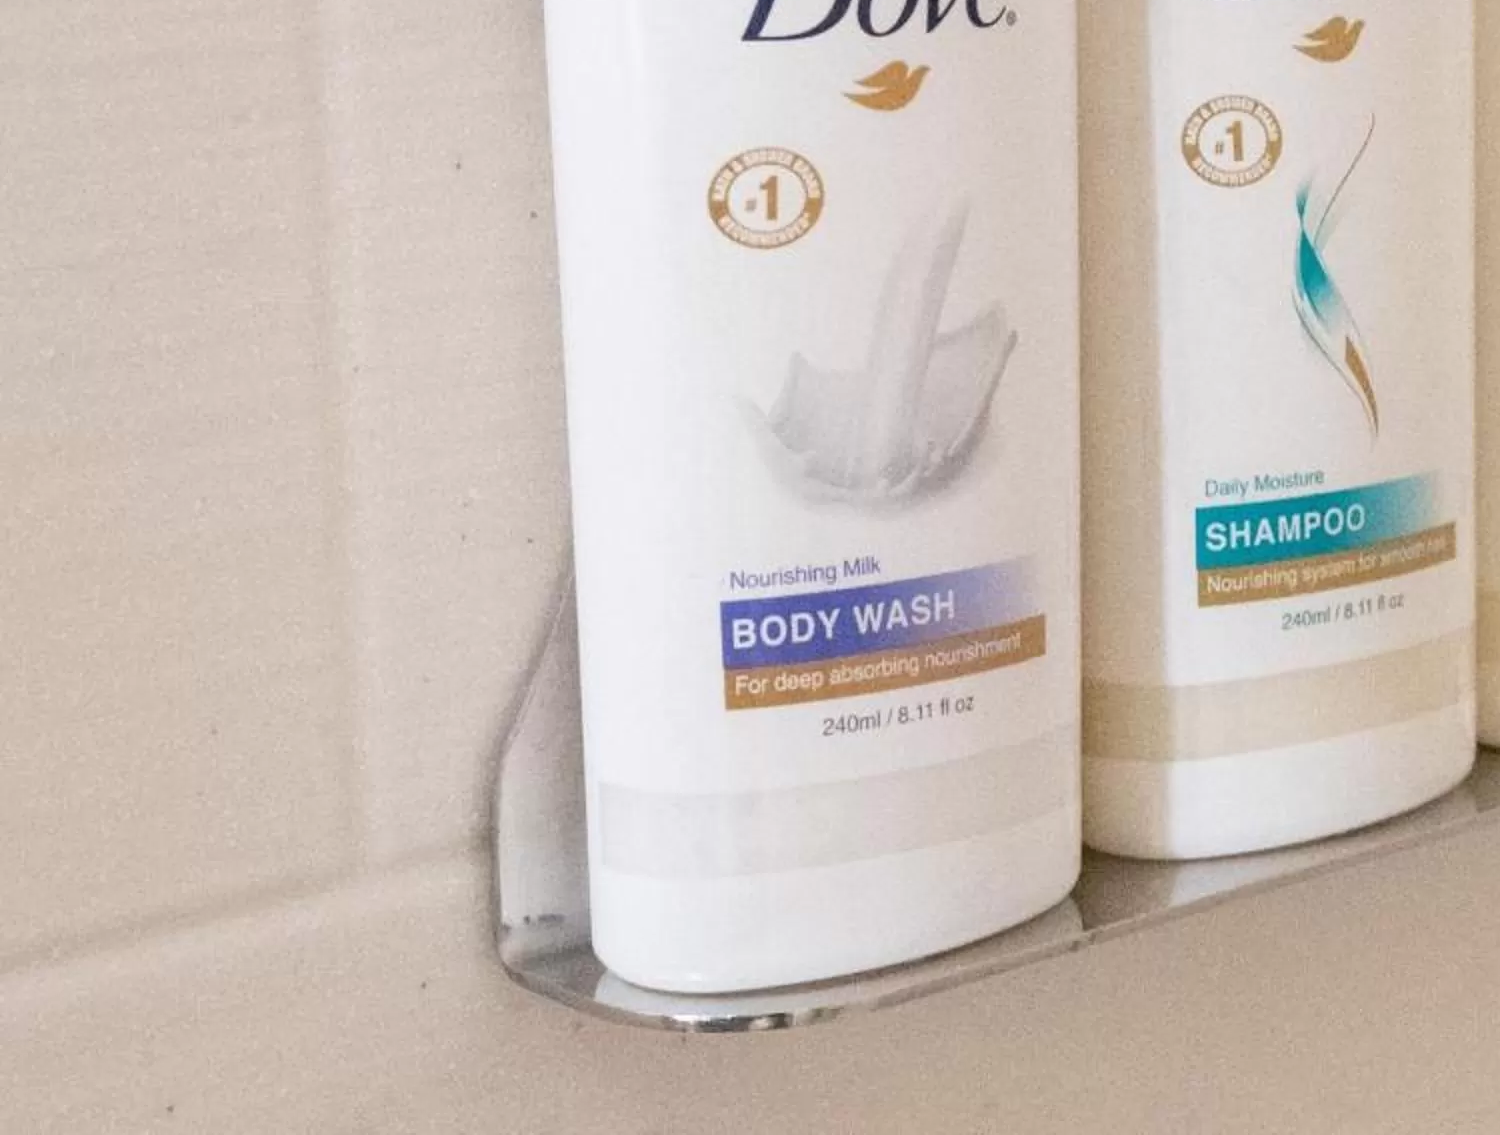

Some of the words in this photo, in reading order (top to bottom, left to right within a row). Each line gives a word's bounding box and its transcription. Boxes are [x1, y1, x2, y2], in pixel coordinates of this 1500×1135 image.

[1205, 476, 1250, 497] Daily
[1254, 470, 1325, 491] Moisture
[1205, 503, 1366, 552] SHAMPOO
[730, 563, 837, 591] Nourishing
[843, 555, 881, 577] Milk
[1206, 568, 1298, 594] Nourishing
[732, 609, 841, 650] BODY
[853, 588, 955, 635] WASH
[1281, 605, 1331, 631] 240ml
[734, 674, 769, 696] For
[773, 669, 825, 692] deep
[829, 652, 920, 686] absorbing
[821, 712, 882, 737] 240ml
[897, 701, 934, 724] 8.11
[954, 695, 975, 714] oz
